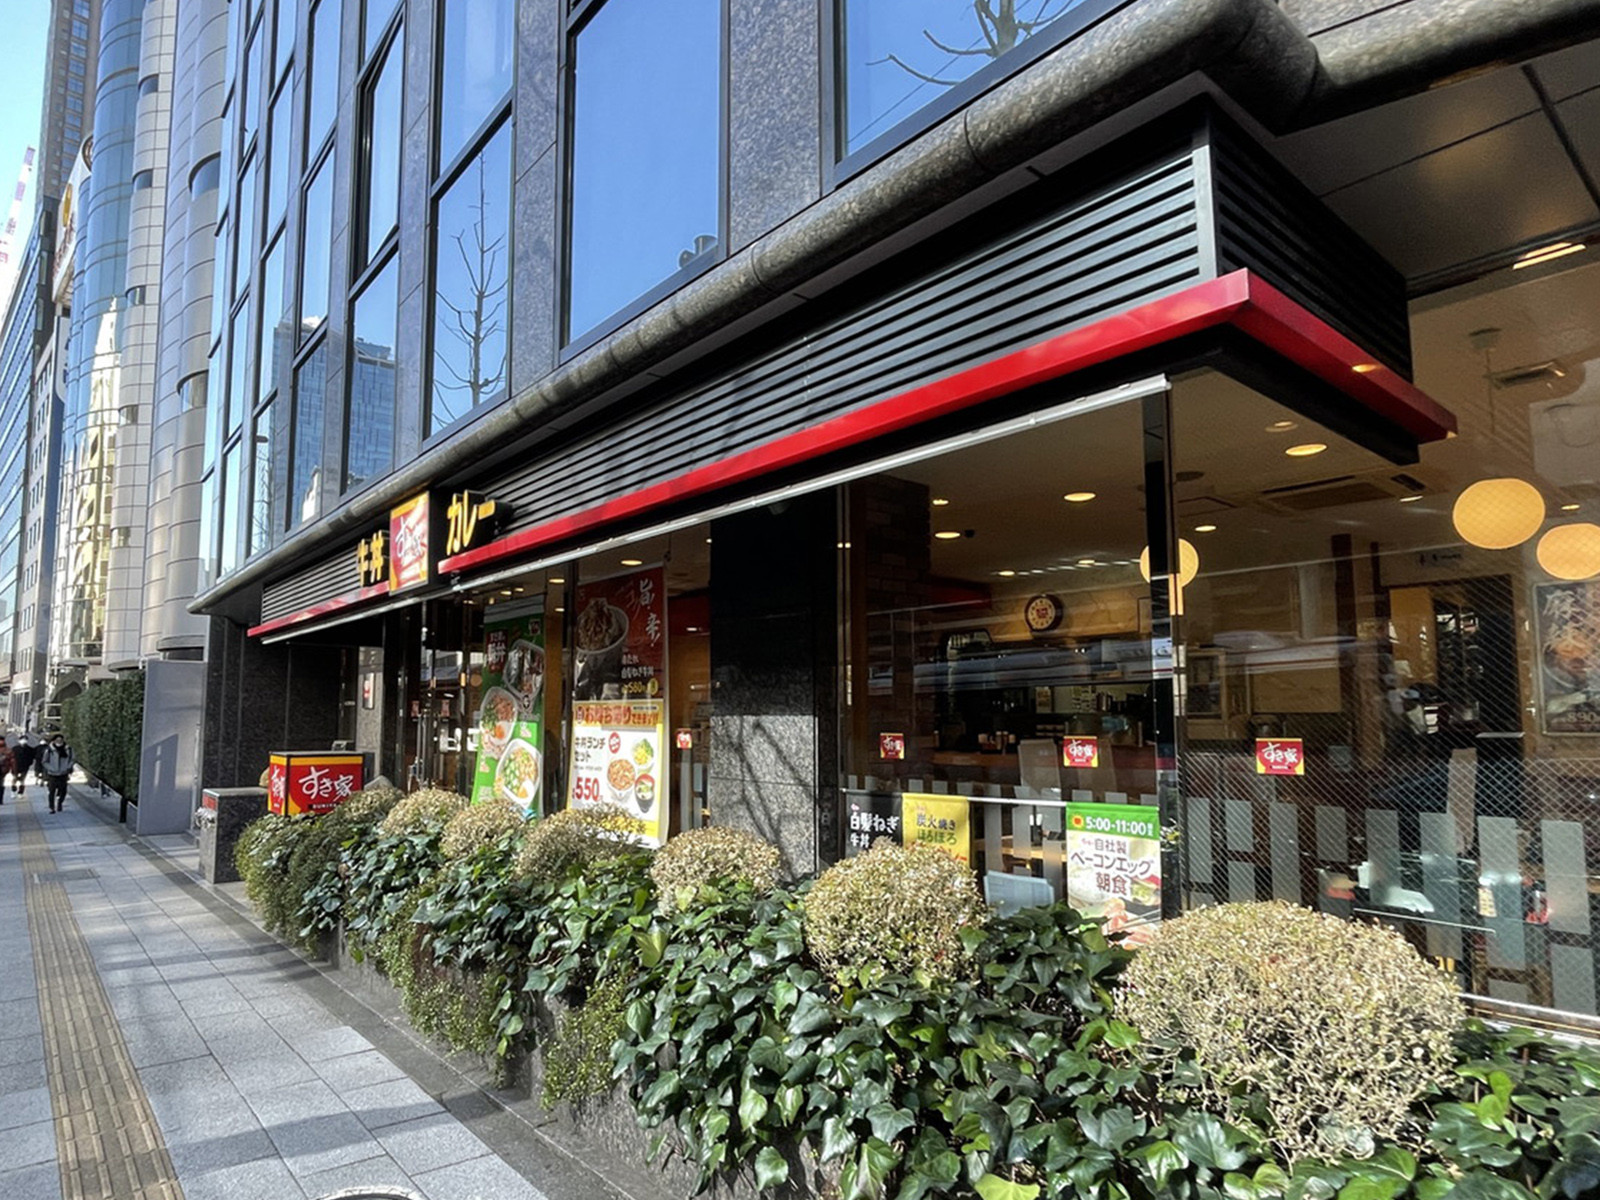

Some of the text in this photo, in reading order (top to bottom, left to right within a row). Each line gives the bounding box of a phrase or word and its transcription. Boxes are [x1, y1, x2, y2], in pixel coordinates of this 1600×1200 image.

[446, 489, 496, 556] カレー
[357, 530, 384, 588] 牛丼
[1262, 741, 1299, 765] すき家
[298, 766, 354, 802] すき家
[575, 776, 600, 802] 550
[850, 811, 900, 833] 白髪ねぎ
[1085, 816, 1147, 836] 5:00-11:00
[1094, 838, 1127, 855] 自社製
[1071, 850, 1155, 876] ベーコンエッグ
[1095, 871, 1128, 896] 朝食
